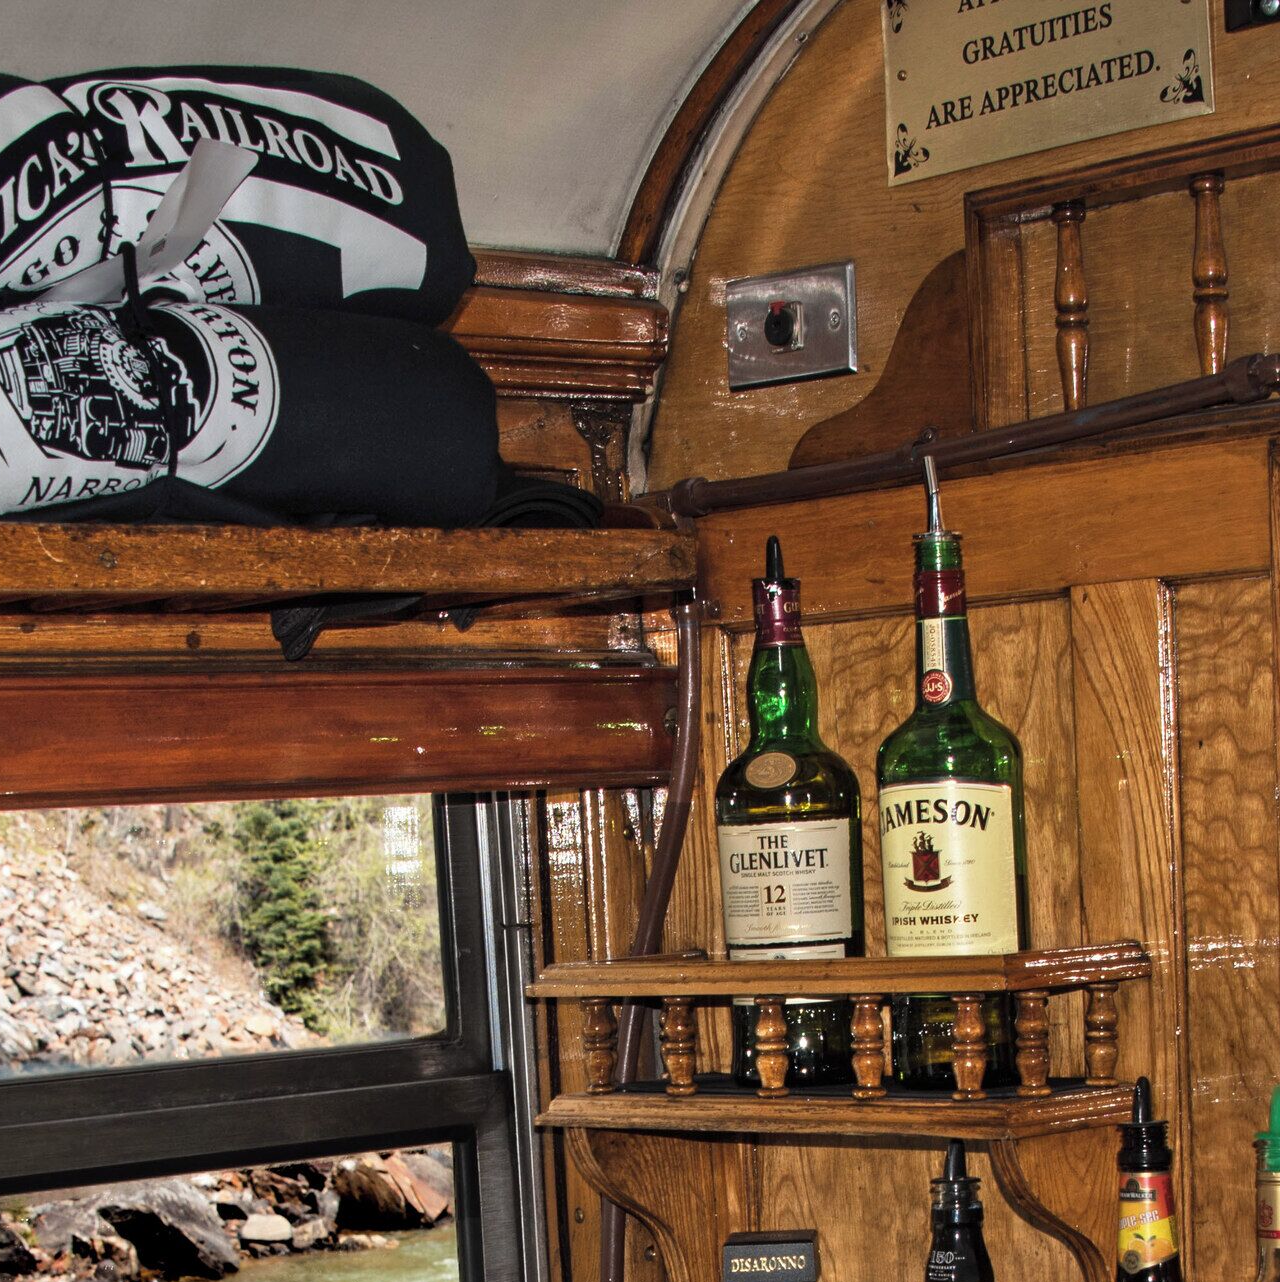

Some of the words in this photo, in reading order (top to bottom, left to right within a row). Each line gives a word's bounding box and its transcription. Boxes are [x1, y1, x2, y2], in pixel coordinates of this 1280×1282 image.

[962, 2, 1113, 65] GRATUITIES
[925, 95, 974, 130] ARE
[979, 49, 1161, 116] APPRECIATED.
[92, 84, 404, 207] RAILROAD
[880, 799, 992, 837] JAMESON
[757, 835, 788, 850] THE
[729, 848, 828, 875] GLENLIVET
[795, 868, 816, 876] WHISKY
[763, 884, 787, 904] 12
[892, 916, 916, 926] IRISH
[920, 914, 980, 925] WHISKEY
[731, 1255, 806, 1273] DISARONNO
[932, 1250, 955, 1264] 150
